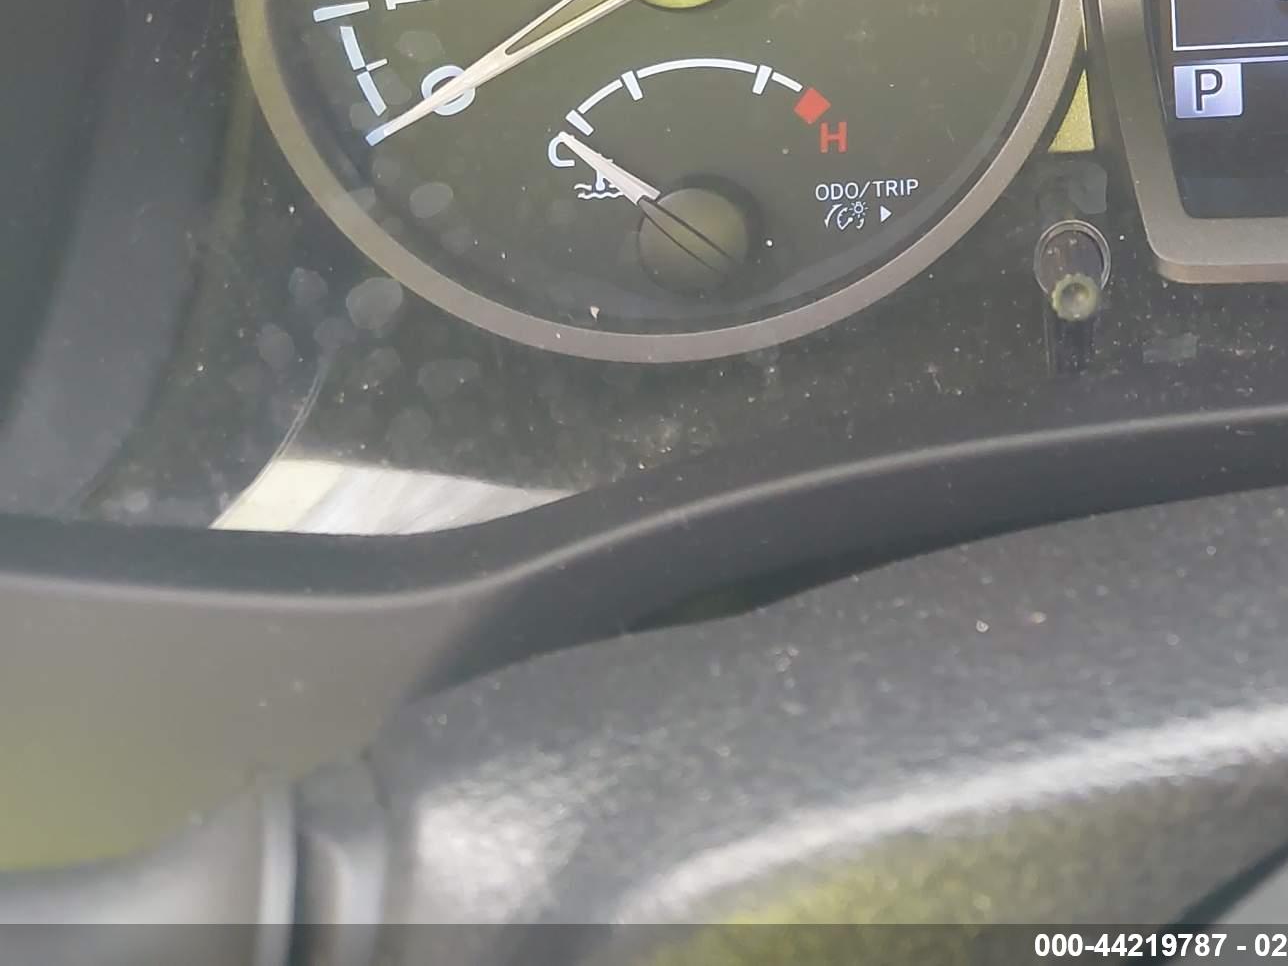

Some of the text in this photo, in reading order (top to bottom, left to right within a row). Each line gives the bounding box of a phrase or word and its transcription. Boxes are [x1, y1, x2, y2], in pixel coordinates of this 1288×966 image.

[421, 64, 476, 116] 0
[1194, 68, 1223, 112] P
[820, 121, 848, 153] H
[815, 178, 919, 202] ODO/TRIP
